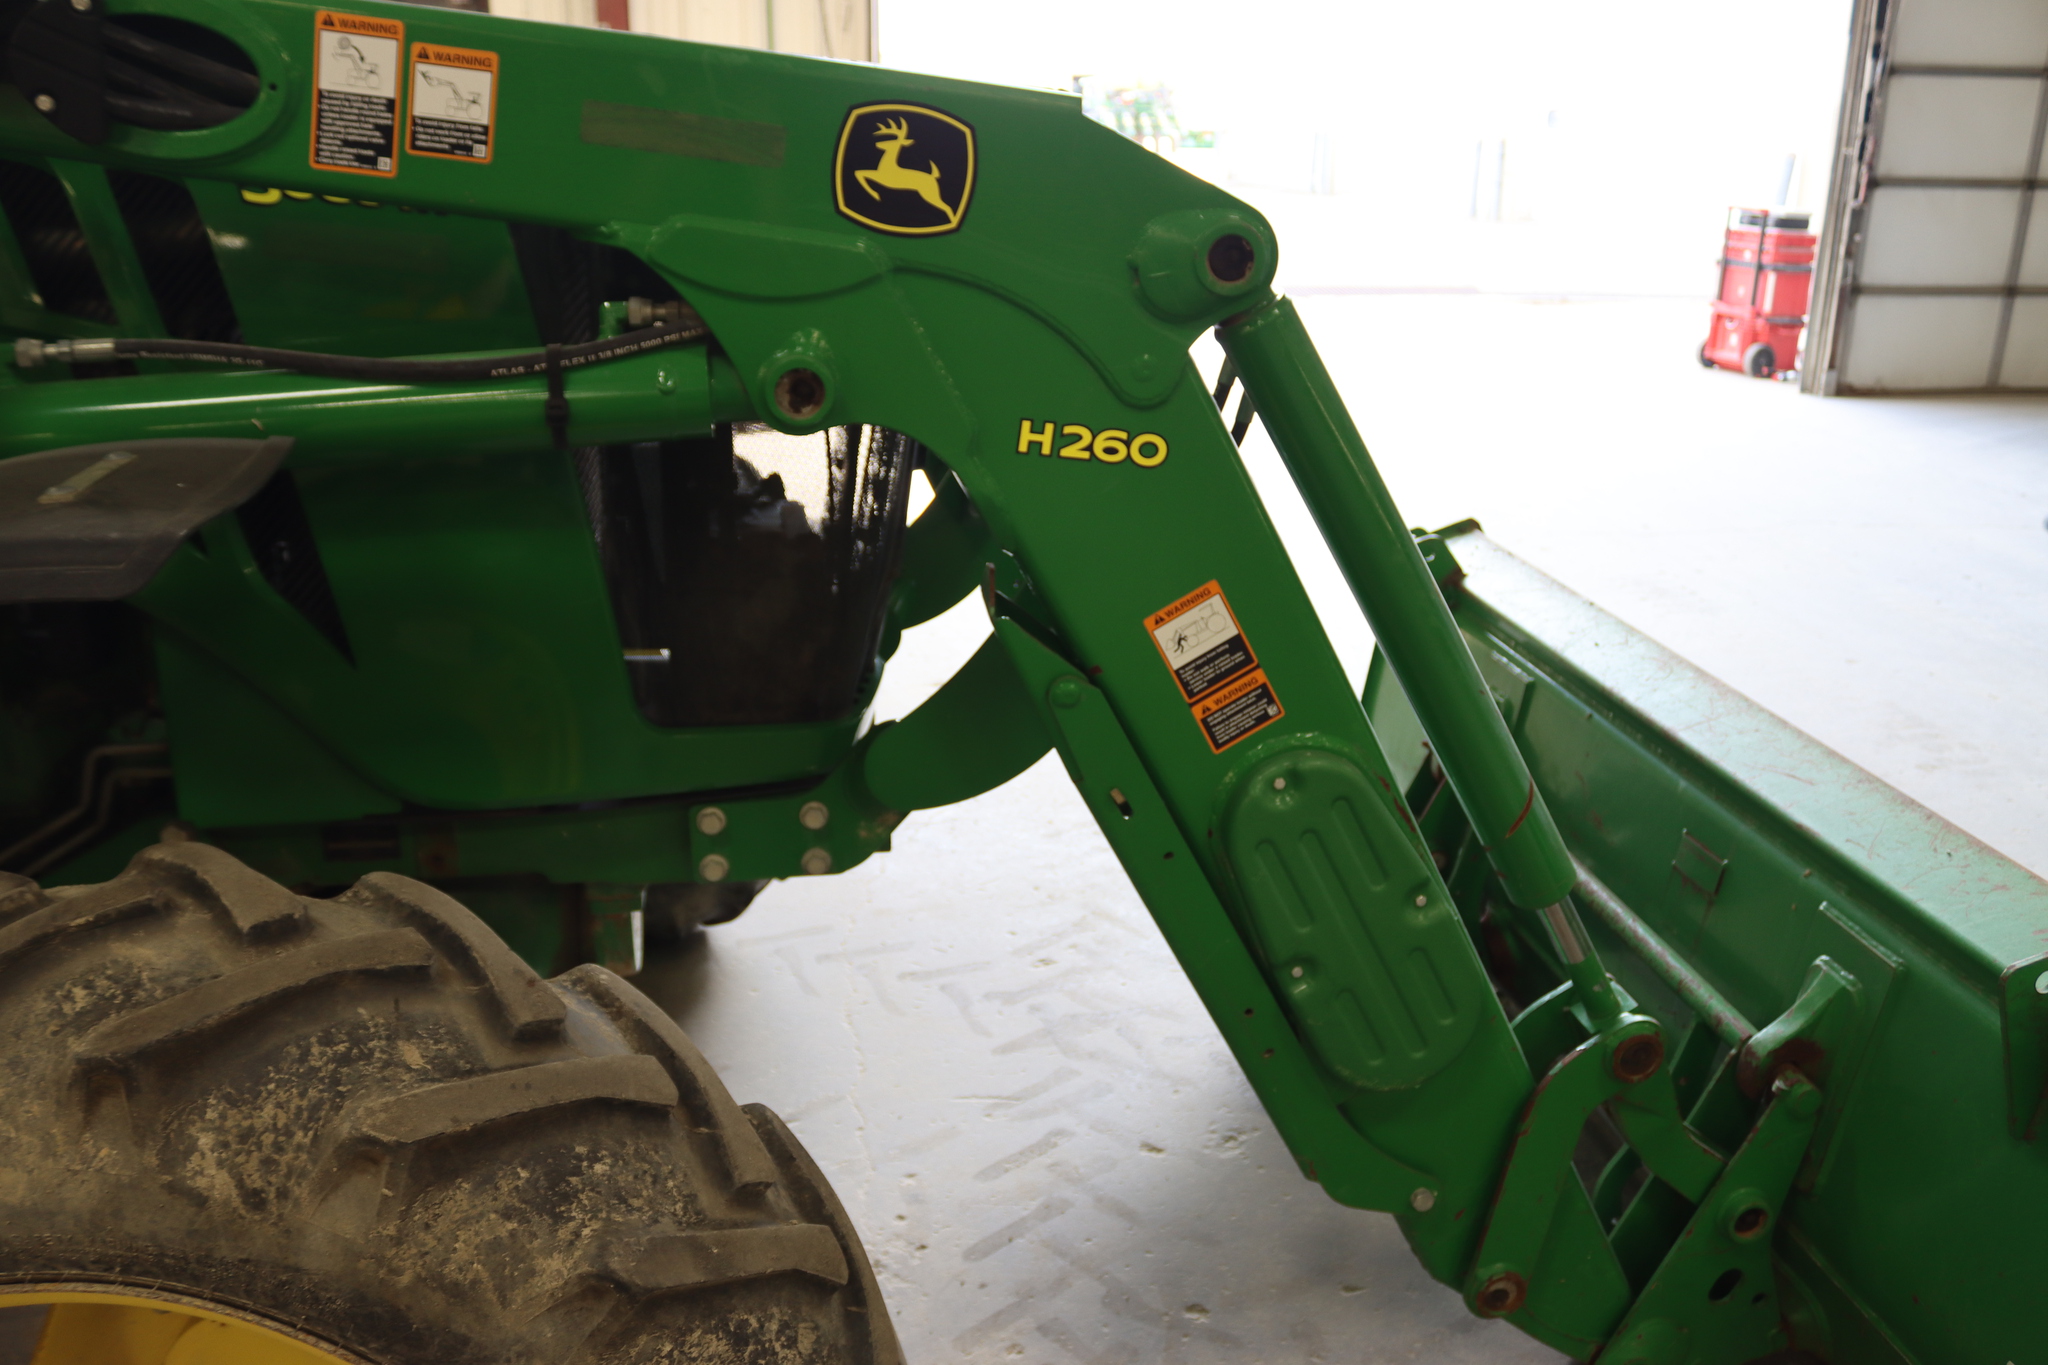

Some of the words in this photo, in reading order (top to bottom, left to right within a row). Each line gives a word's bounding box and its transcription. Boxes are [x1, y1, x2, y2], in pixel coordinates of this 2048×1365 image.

[338, 18, 398, 35] WARNING
[433, 51, 492, 67] WARNING
[491, 365, 525, 377] ATLAS
[598, 351, 612, 360] 3/8
[614, 345, 638, 357] INCH
[640, 338, 662, 349] 5000
[664, 334, 680, 344] PSI
[1017, 418, 1169, 468] H260
[1165, 587, 1212, 617] WARNING
[1212, 676, 1258, 706] WARNING
